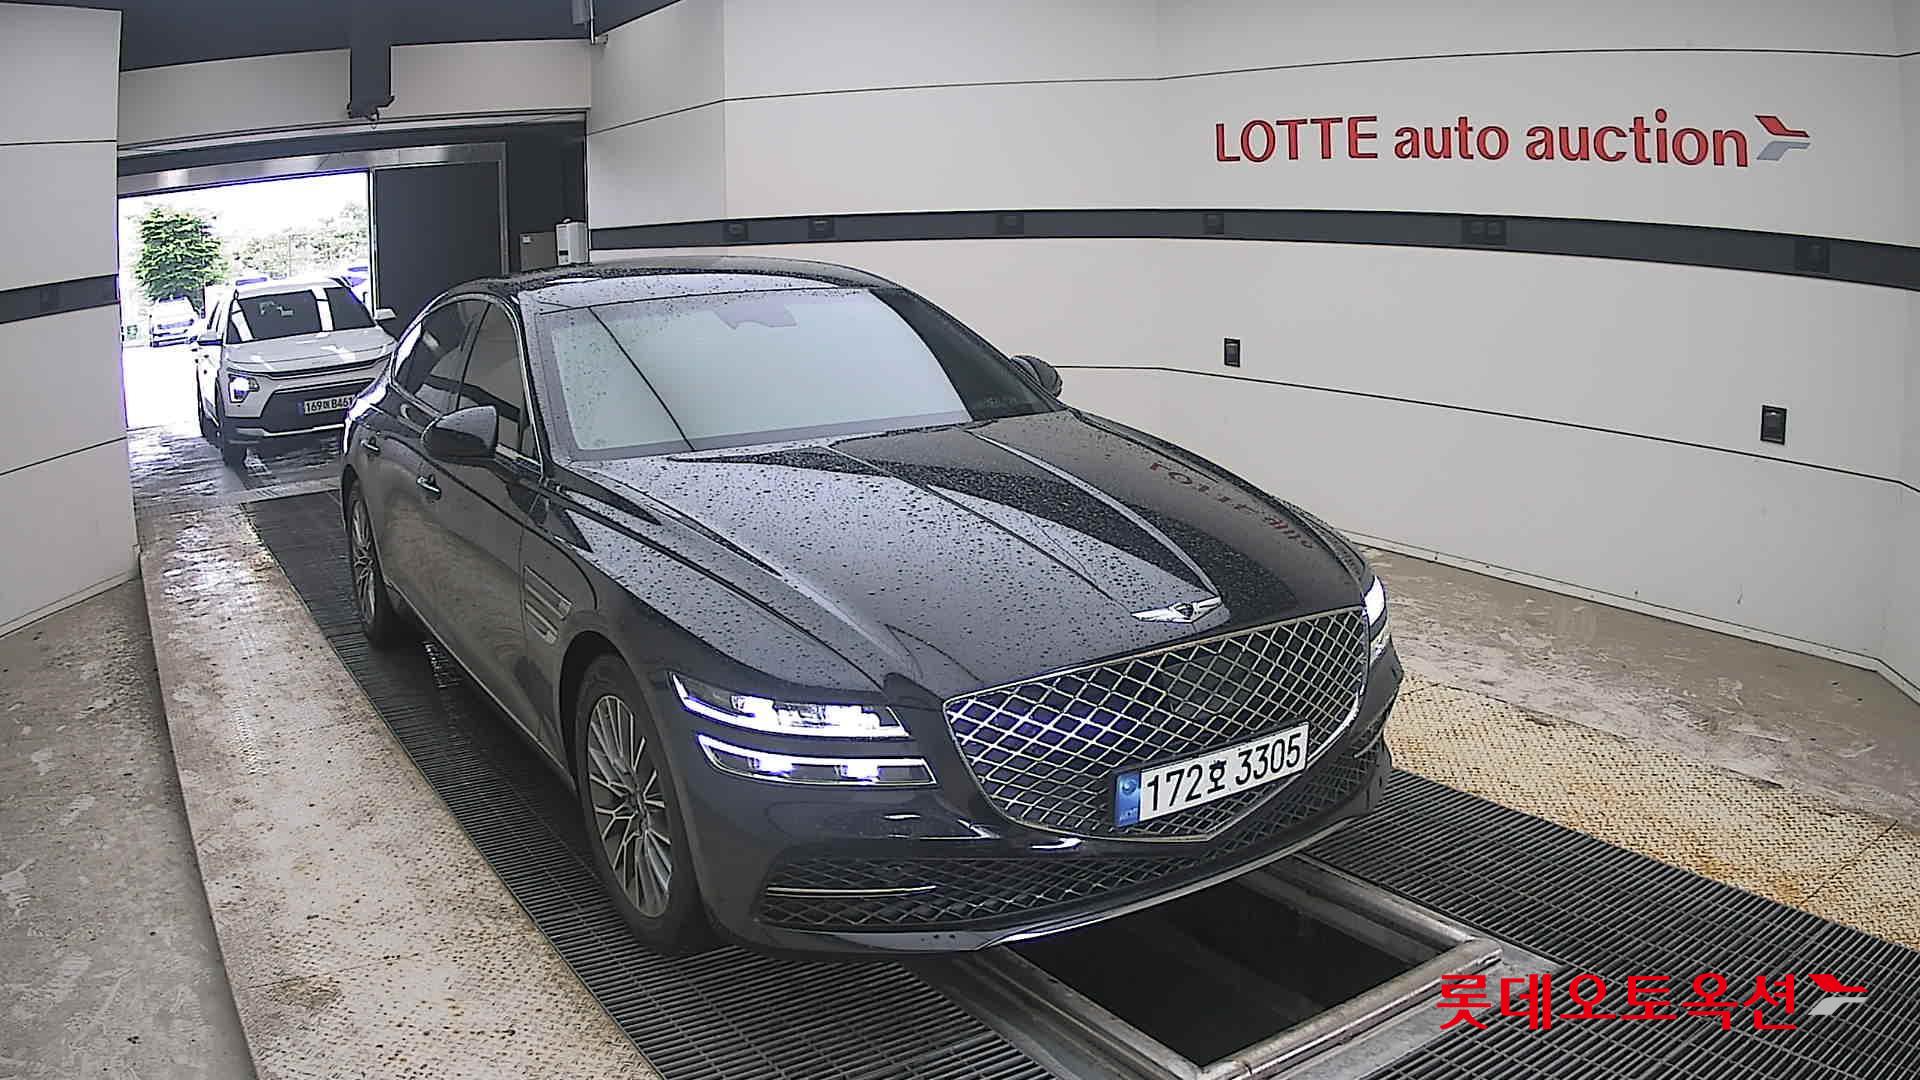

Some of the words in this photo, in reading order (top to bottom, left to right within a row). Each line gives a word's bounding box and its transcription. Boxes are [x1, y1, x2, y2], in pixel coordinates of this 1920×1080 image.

[1215, 115, 1379, 163] LOTTE
[1394, 116, 1510, 160] auto
[1525, 108, 1749, 167] auction
[1146, 759, 1227, 812] 172호
[1235, 732, 1301, 786] 3305
